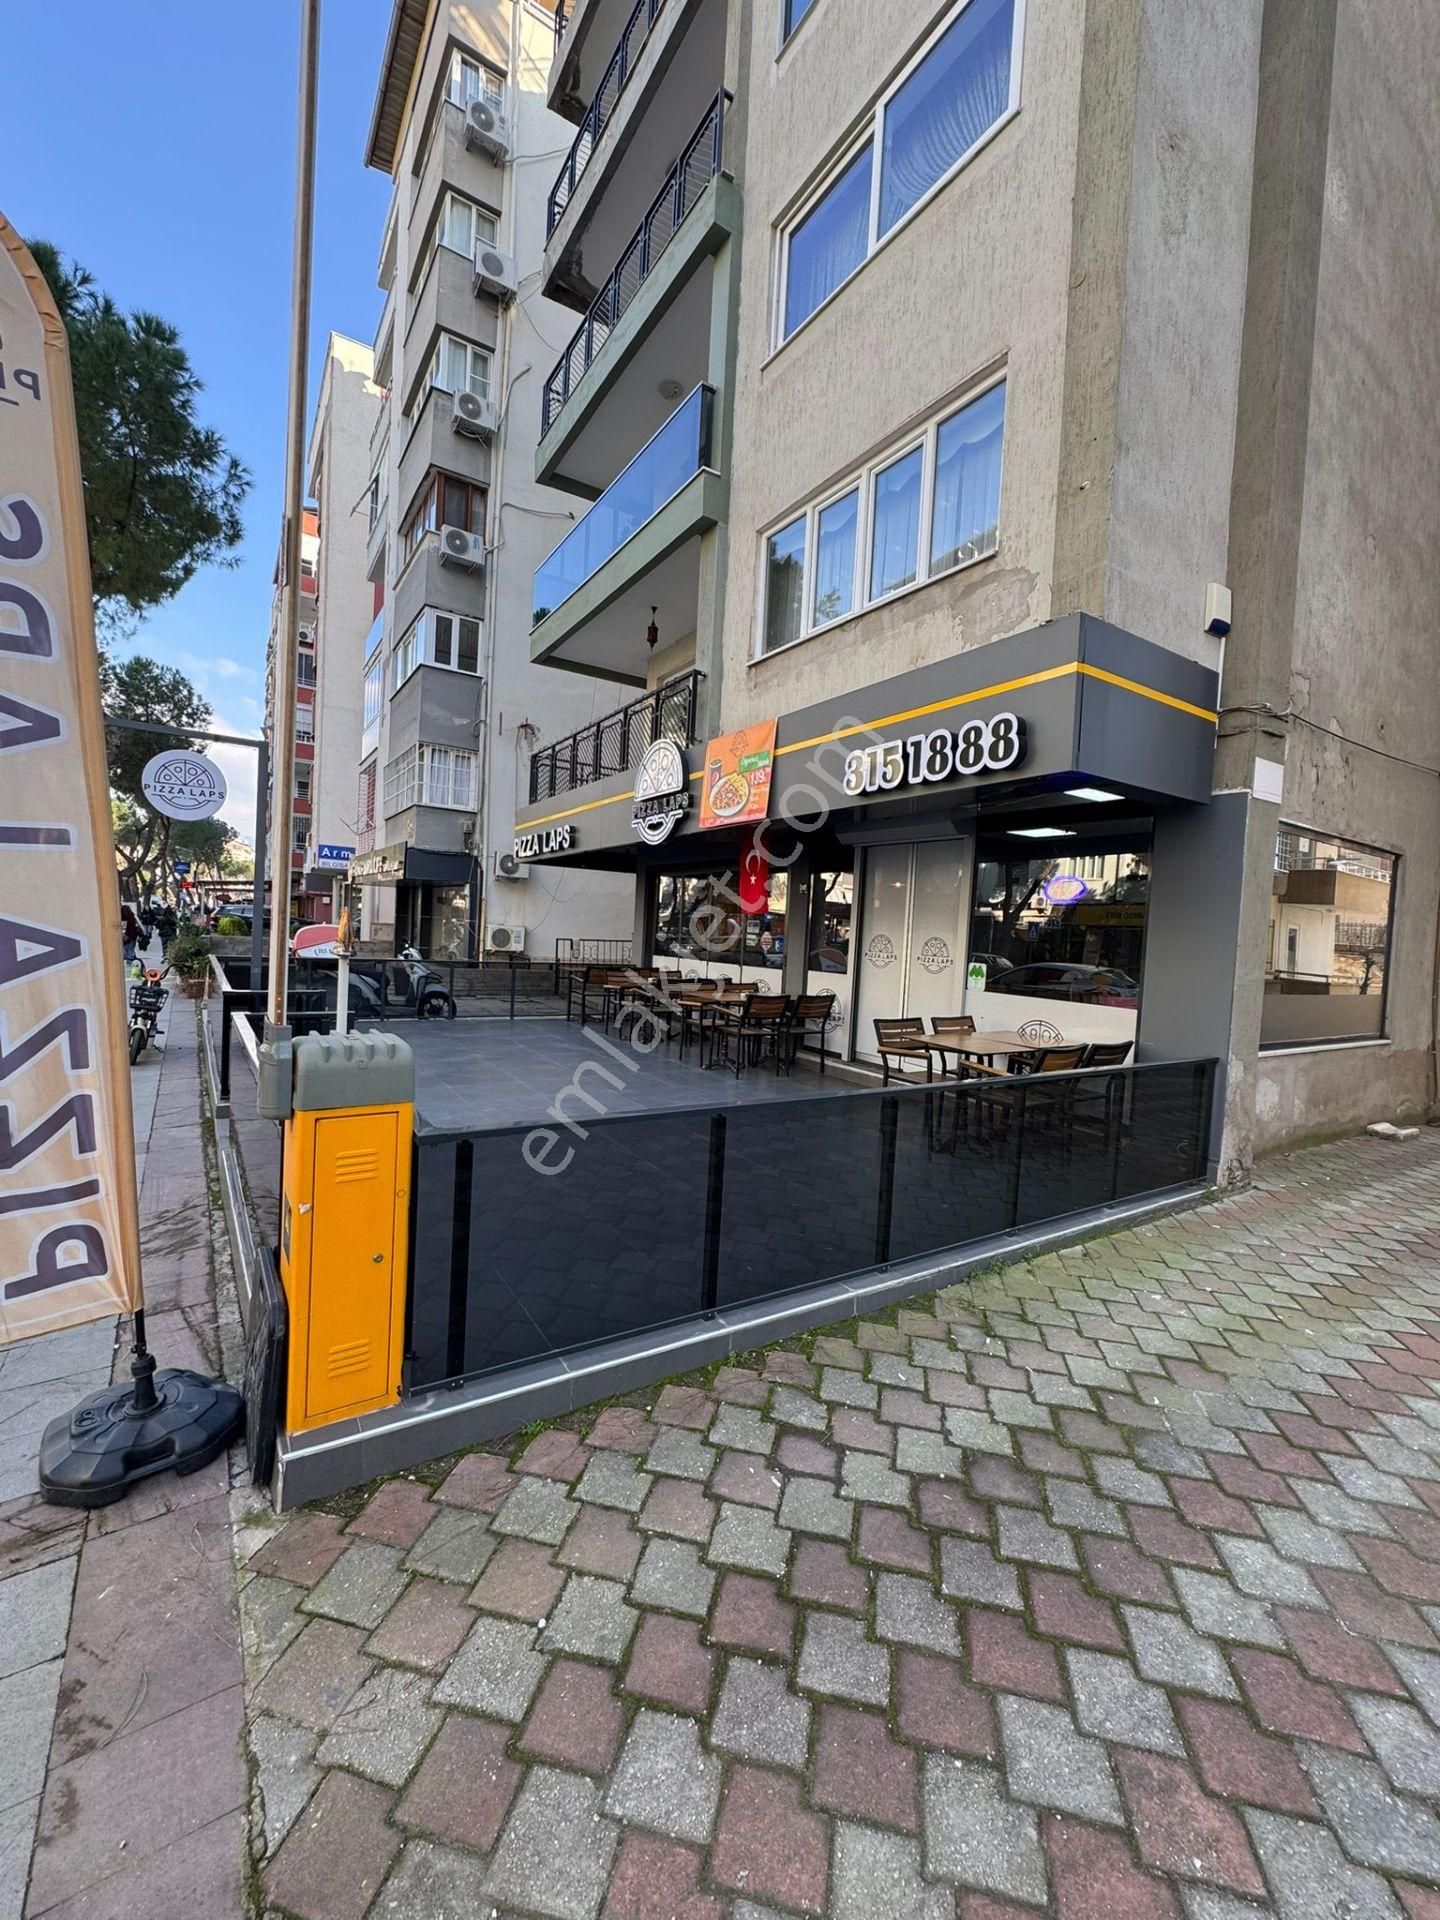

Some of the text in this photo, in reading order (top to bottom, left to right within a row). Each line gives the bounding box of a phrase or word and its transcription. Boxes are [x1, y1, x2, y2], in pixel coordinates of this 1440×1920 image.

[843, 739, 904, 796] 315
[144, 783, 225, 799] PIZZA LAPS
[632, 793, 690, 820] PIZZA LAPS
[514, 824, 572, 859] PIZZA LAPS
[936, 957, 954, 965] LAPS
